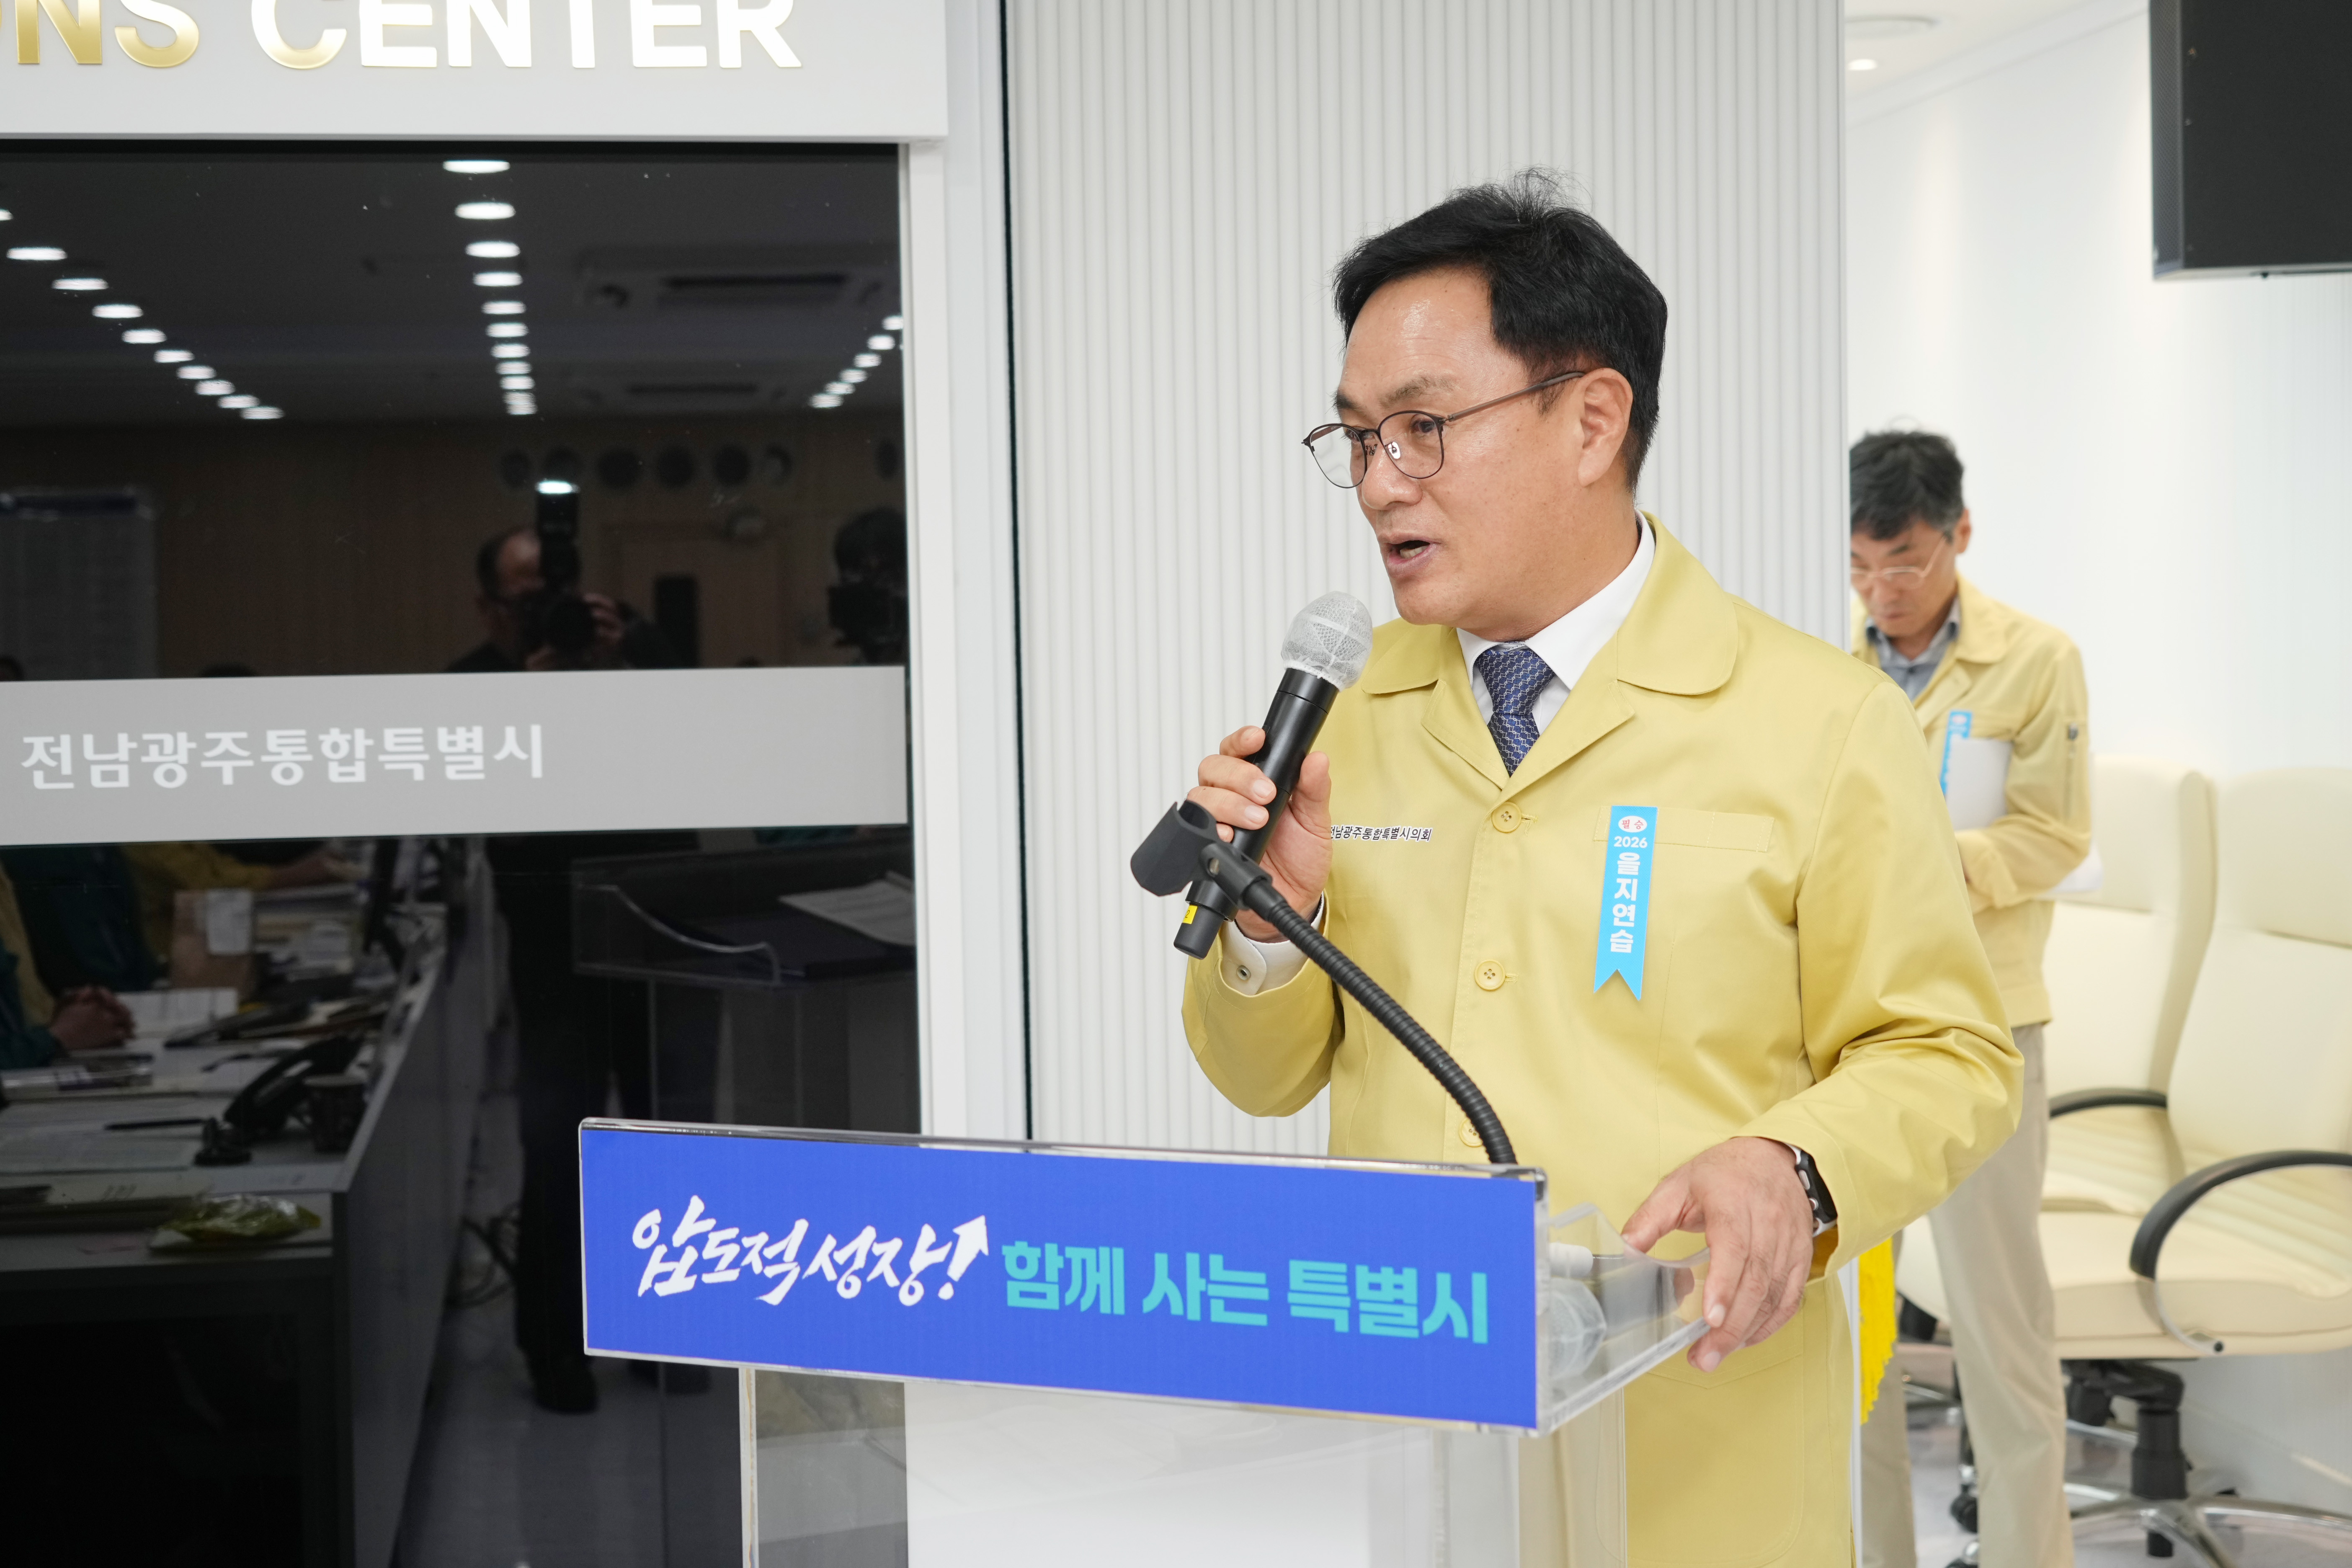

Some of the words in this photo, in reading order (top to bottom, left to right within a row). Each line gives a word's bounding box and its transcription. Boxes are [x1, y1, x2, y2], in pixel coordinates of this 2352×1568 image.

[0, 0, 199, 68] NS
[21, 725, 543, 789] 전남광주통합특별시
[1614, 836, 1648, 848] 2026
[1610, 852, 1640, 953] 을지연습
[632, 1195, 809, 1305] 압도적
[802, 1215, 989, 1306] 성장!
[1002, 1241, 1125, 1315] 함께
[1142, 1252, 1269, 1326] 사는
[1287, 1259, 1488, 1344] 특별시
